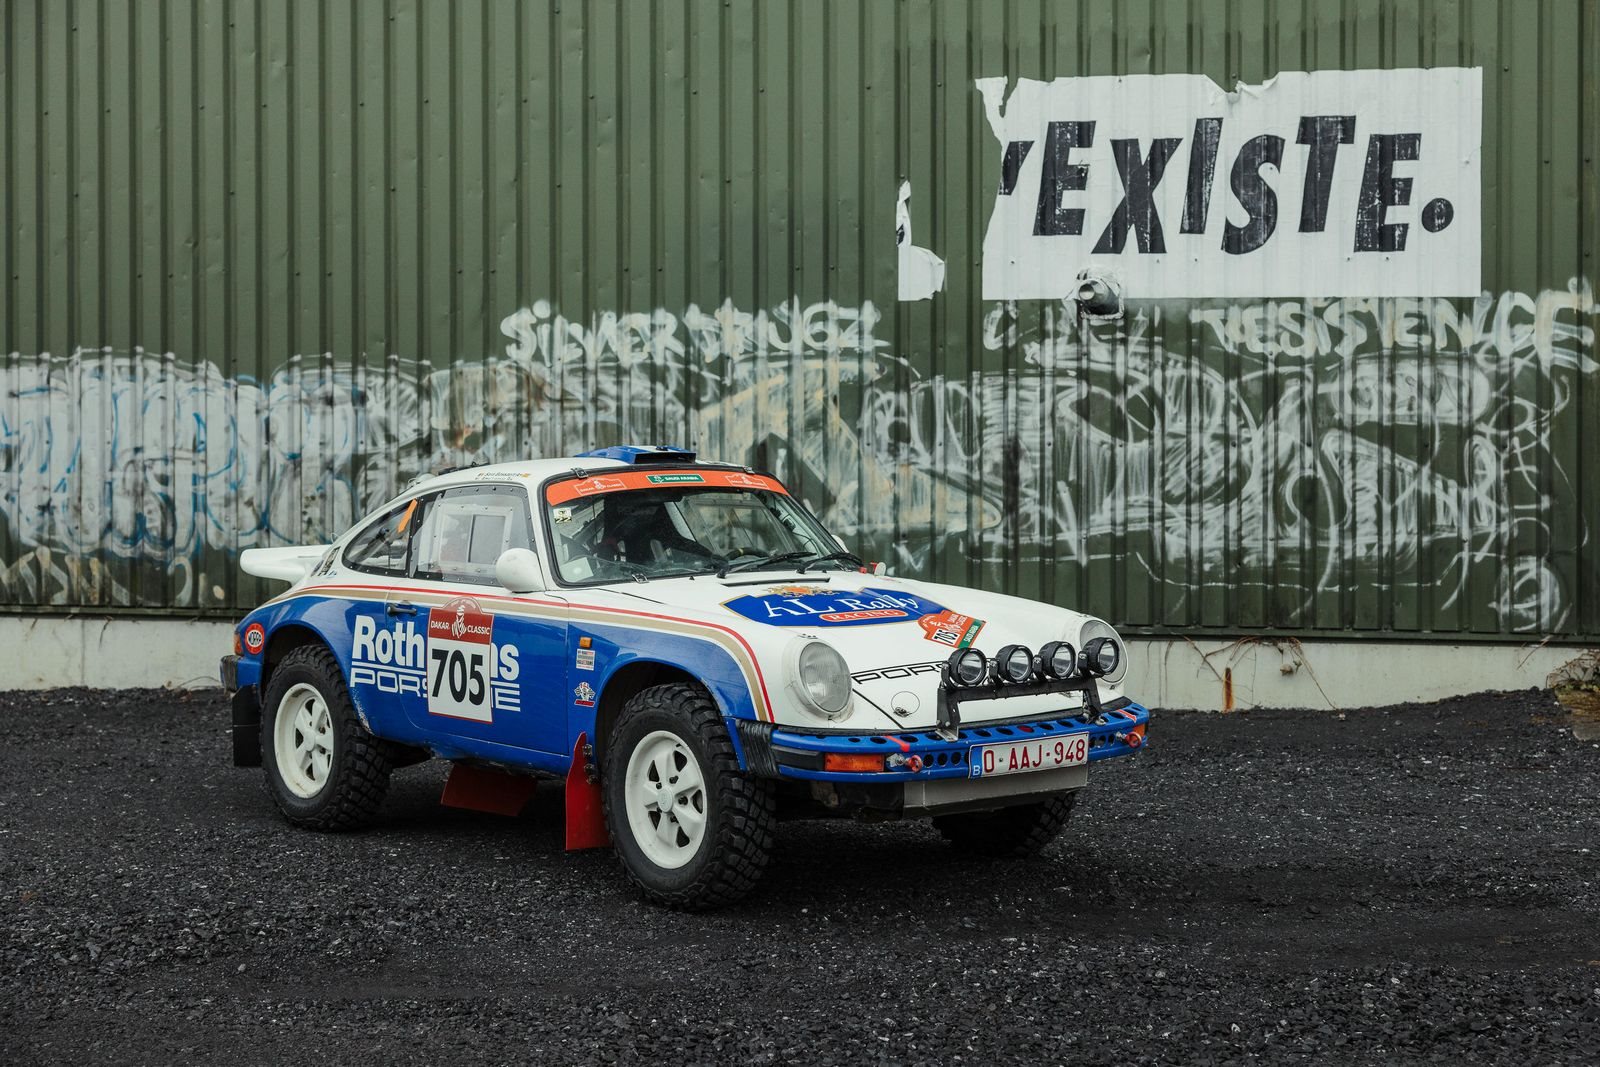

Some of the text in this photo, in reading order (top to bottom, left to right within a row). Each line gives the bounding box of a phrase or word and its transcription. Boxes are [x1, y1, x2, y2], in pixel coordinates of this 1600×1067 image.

[763, 594, 919, 618] AL Rally
[829, 610, 899, 621] RACING
[430, 620, 491, 635] DAKAR CLASSIC
[431, 648, 486, 706] 705
[973, 765, 981, 776] B
